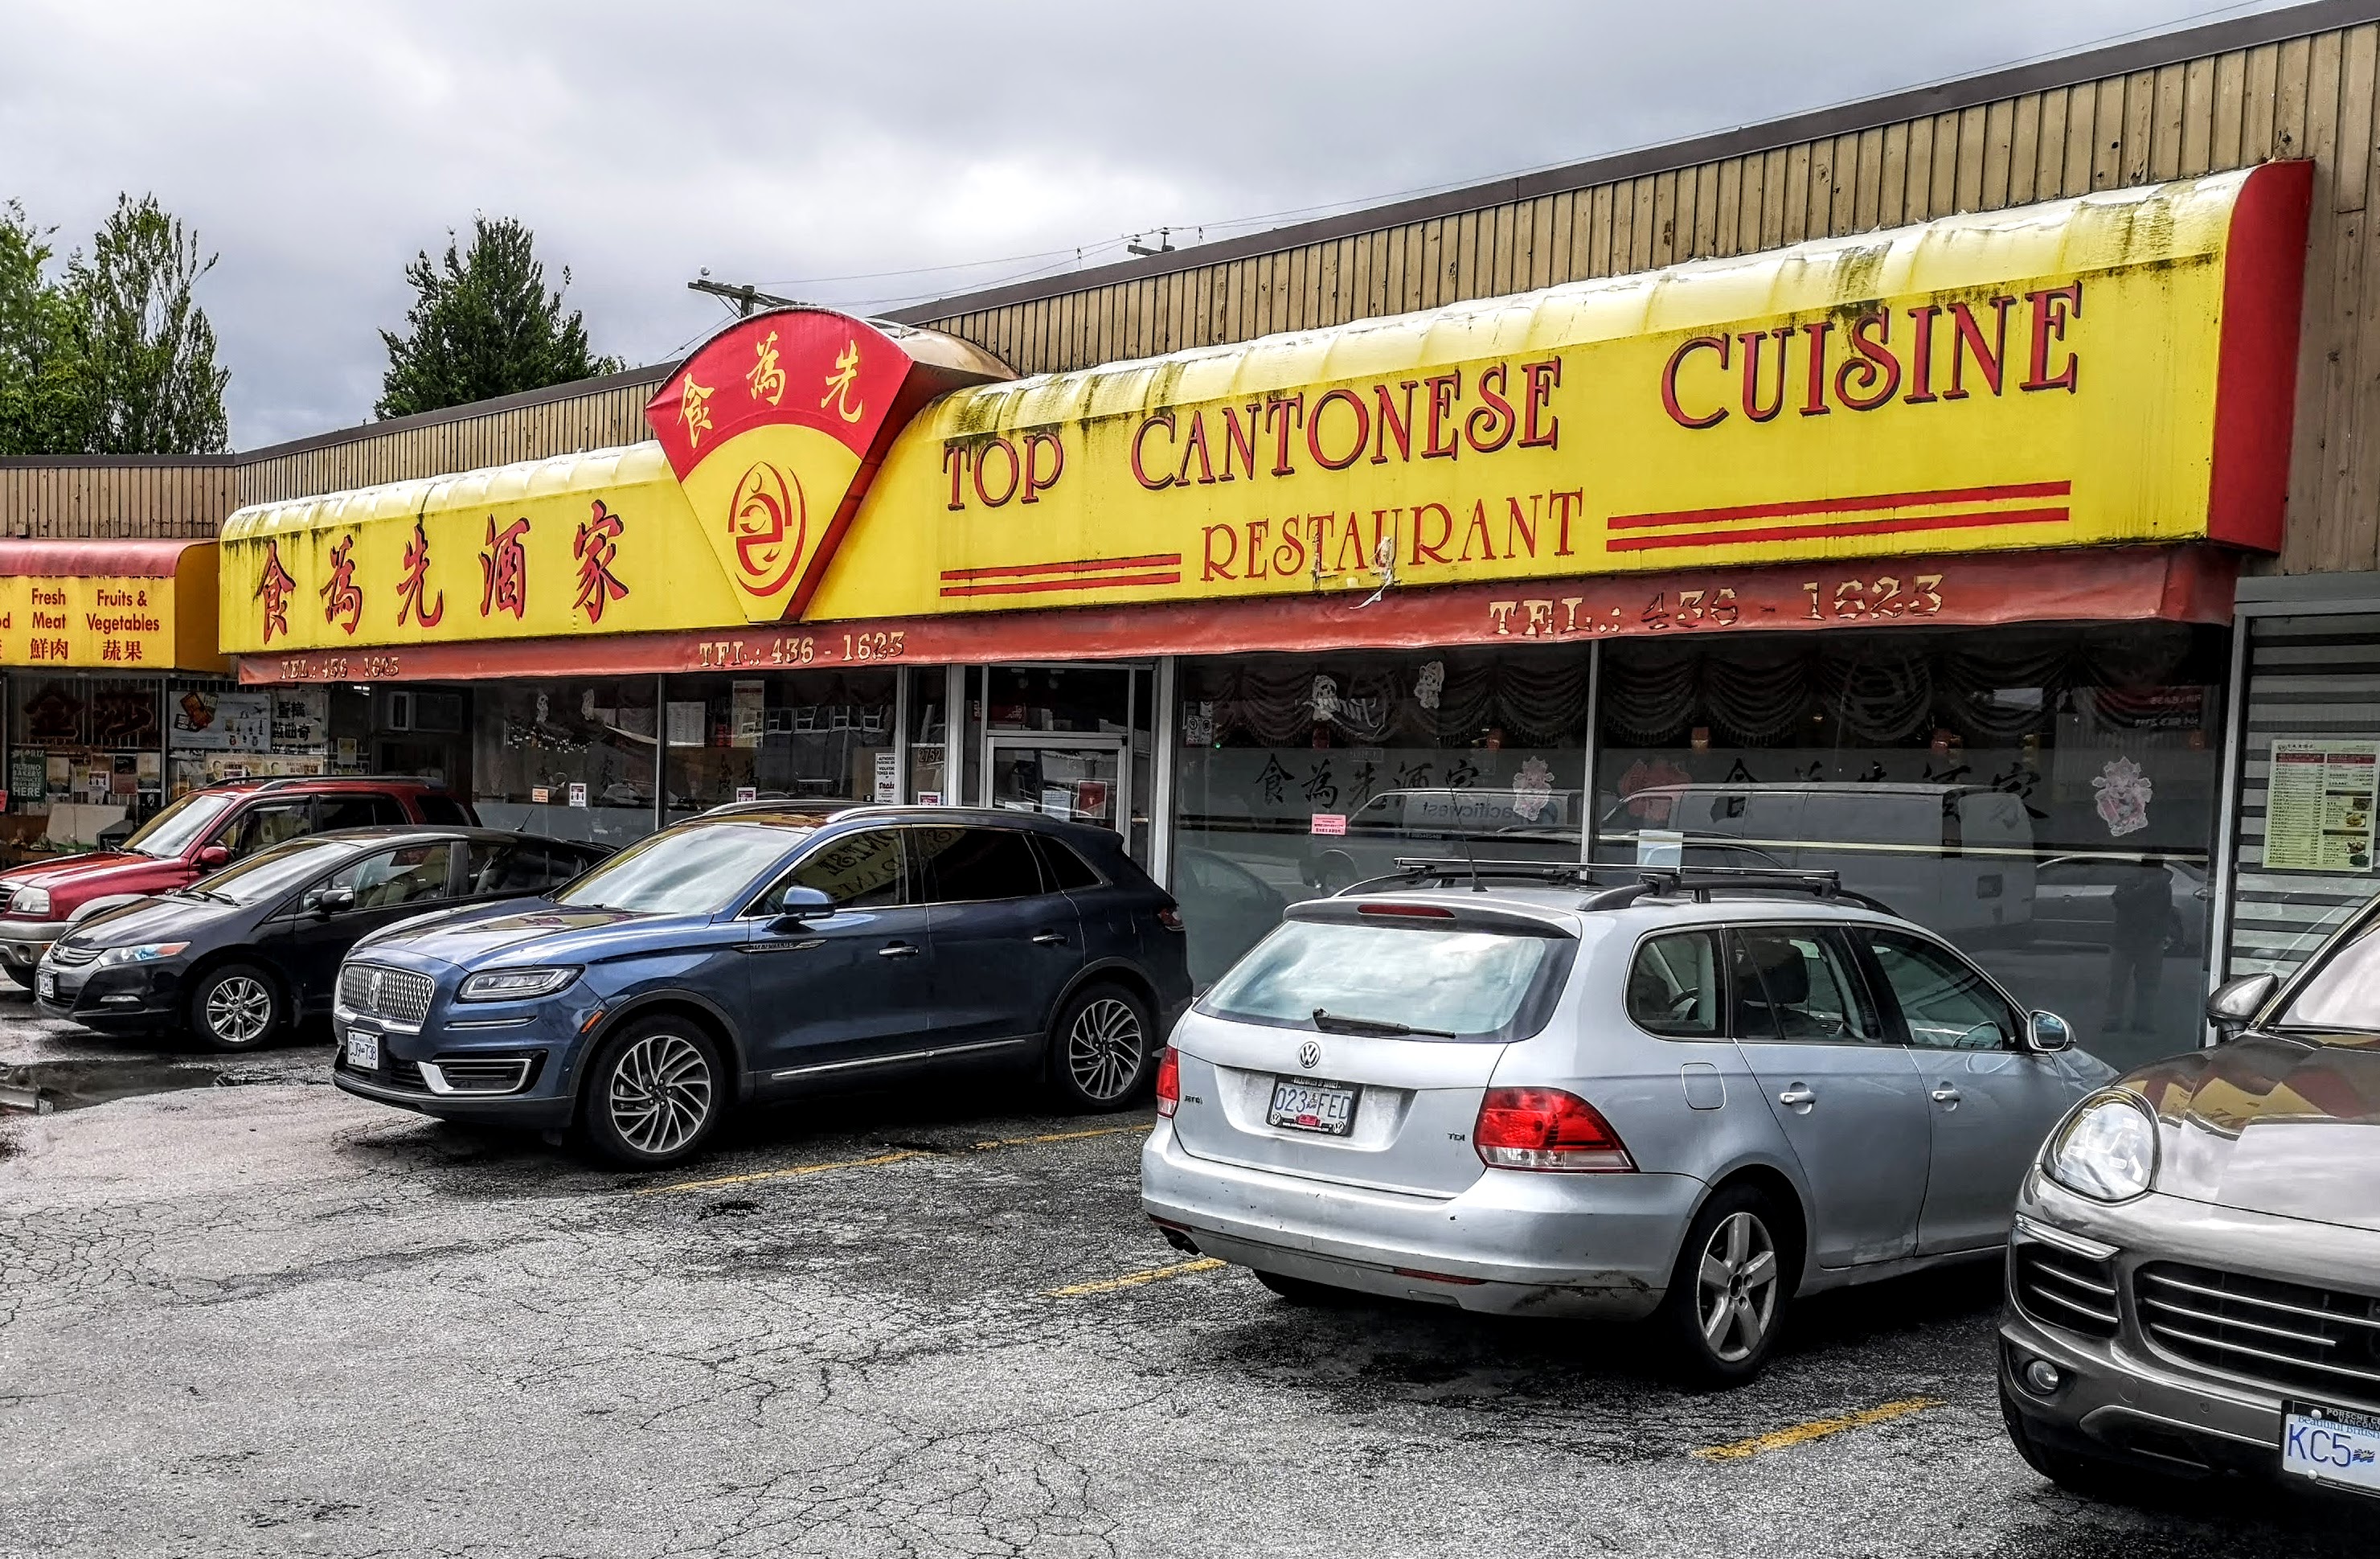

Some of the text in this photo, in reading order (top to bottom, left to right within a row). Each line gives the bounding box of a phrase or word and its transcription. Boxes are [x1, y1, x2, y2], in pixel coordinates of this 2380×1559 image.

[677, 330, 863, 449] 食為先
[943, 279, 2084, 511] TOP CANTONESE CUISINE
[1201, 487, 1584, 582] RESTAURANT
[256, 498, 630, 645] 食為先酒家
[31, 588, 66, 605] Fresh
[97, 589, 148, 607] Fruits &
[31, 612, 67, 630] Meat
[86, 613, 160, 635] Vegetables
[30, 638, 69, 660] 鮮肉
[102, 639, 142, 662] 蔬果
[919, 748, 942, 763] 2752
[13, 787, 41, 797] HERE
[1447, 1133, 1465, 1142] TDI
[2326, 1408, 2369, 1422] PORSCHE
[2288, 1422, 2351, 1468] KC5
